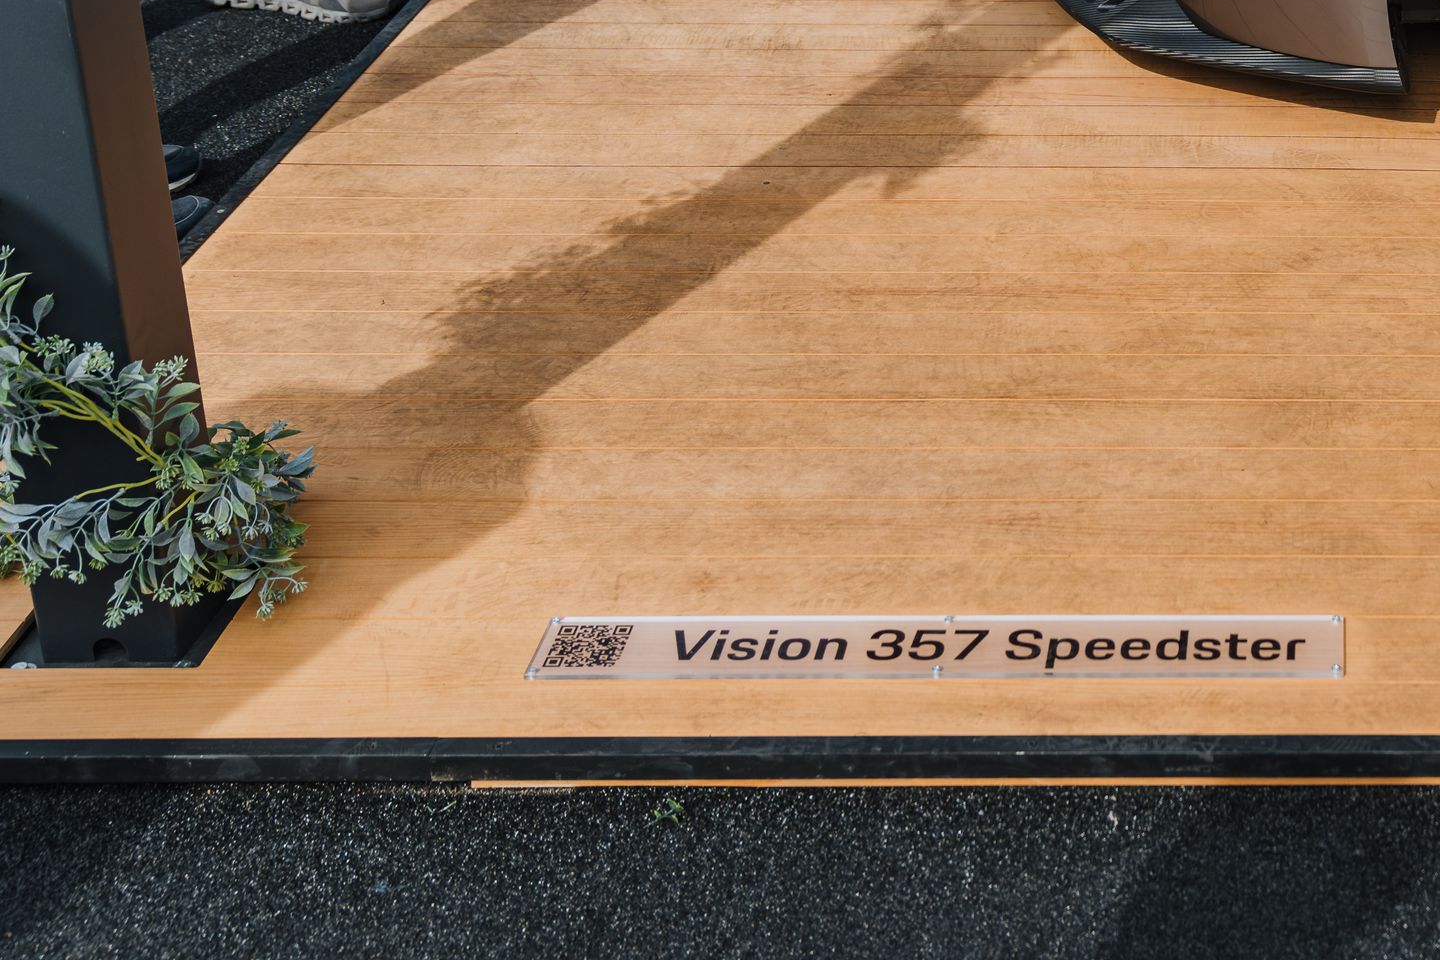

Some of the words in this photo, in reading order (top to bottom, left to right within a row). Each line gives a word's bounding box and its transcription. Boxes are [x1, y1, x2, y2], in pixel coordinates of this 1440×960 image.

[675, 629, 848, 661] Vision
[866, 629, 990, 661] 357
[1005, 629, 1306, 669] Speedster
